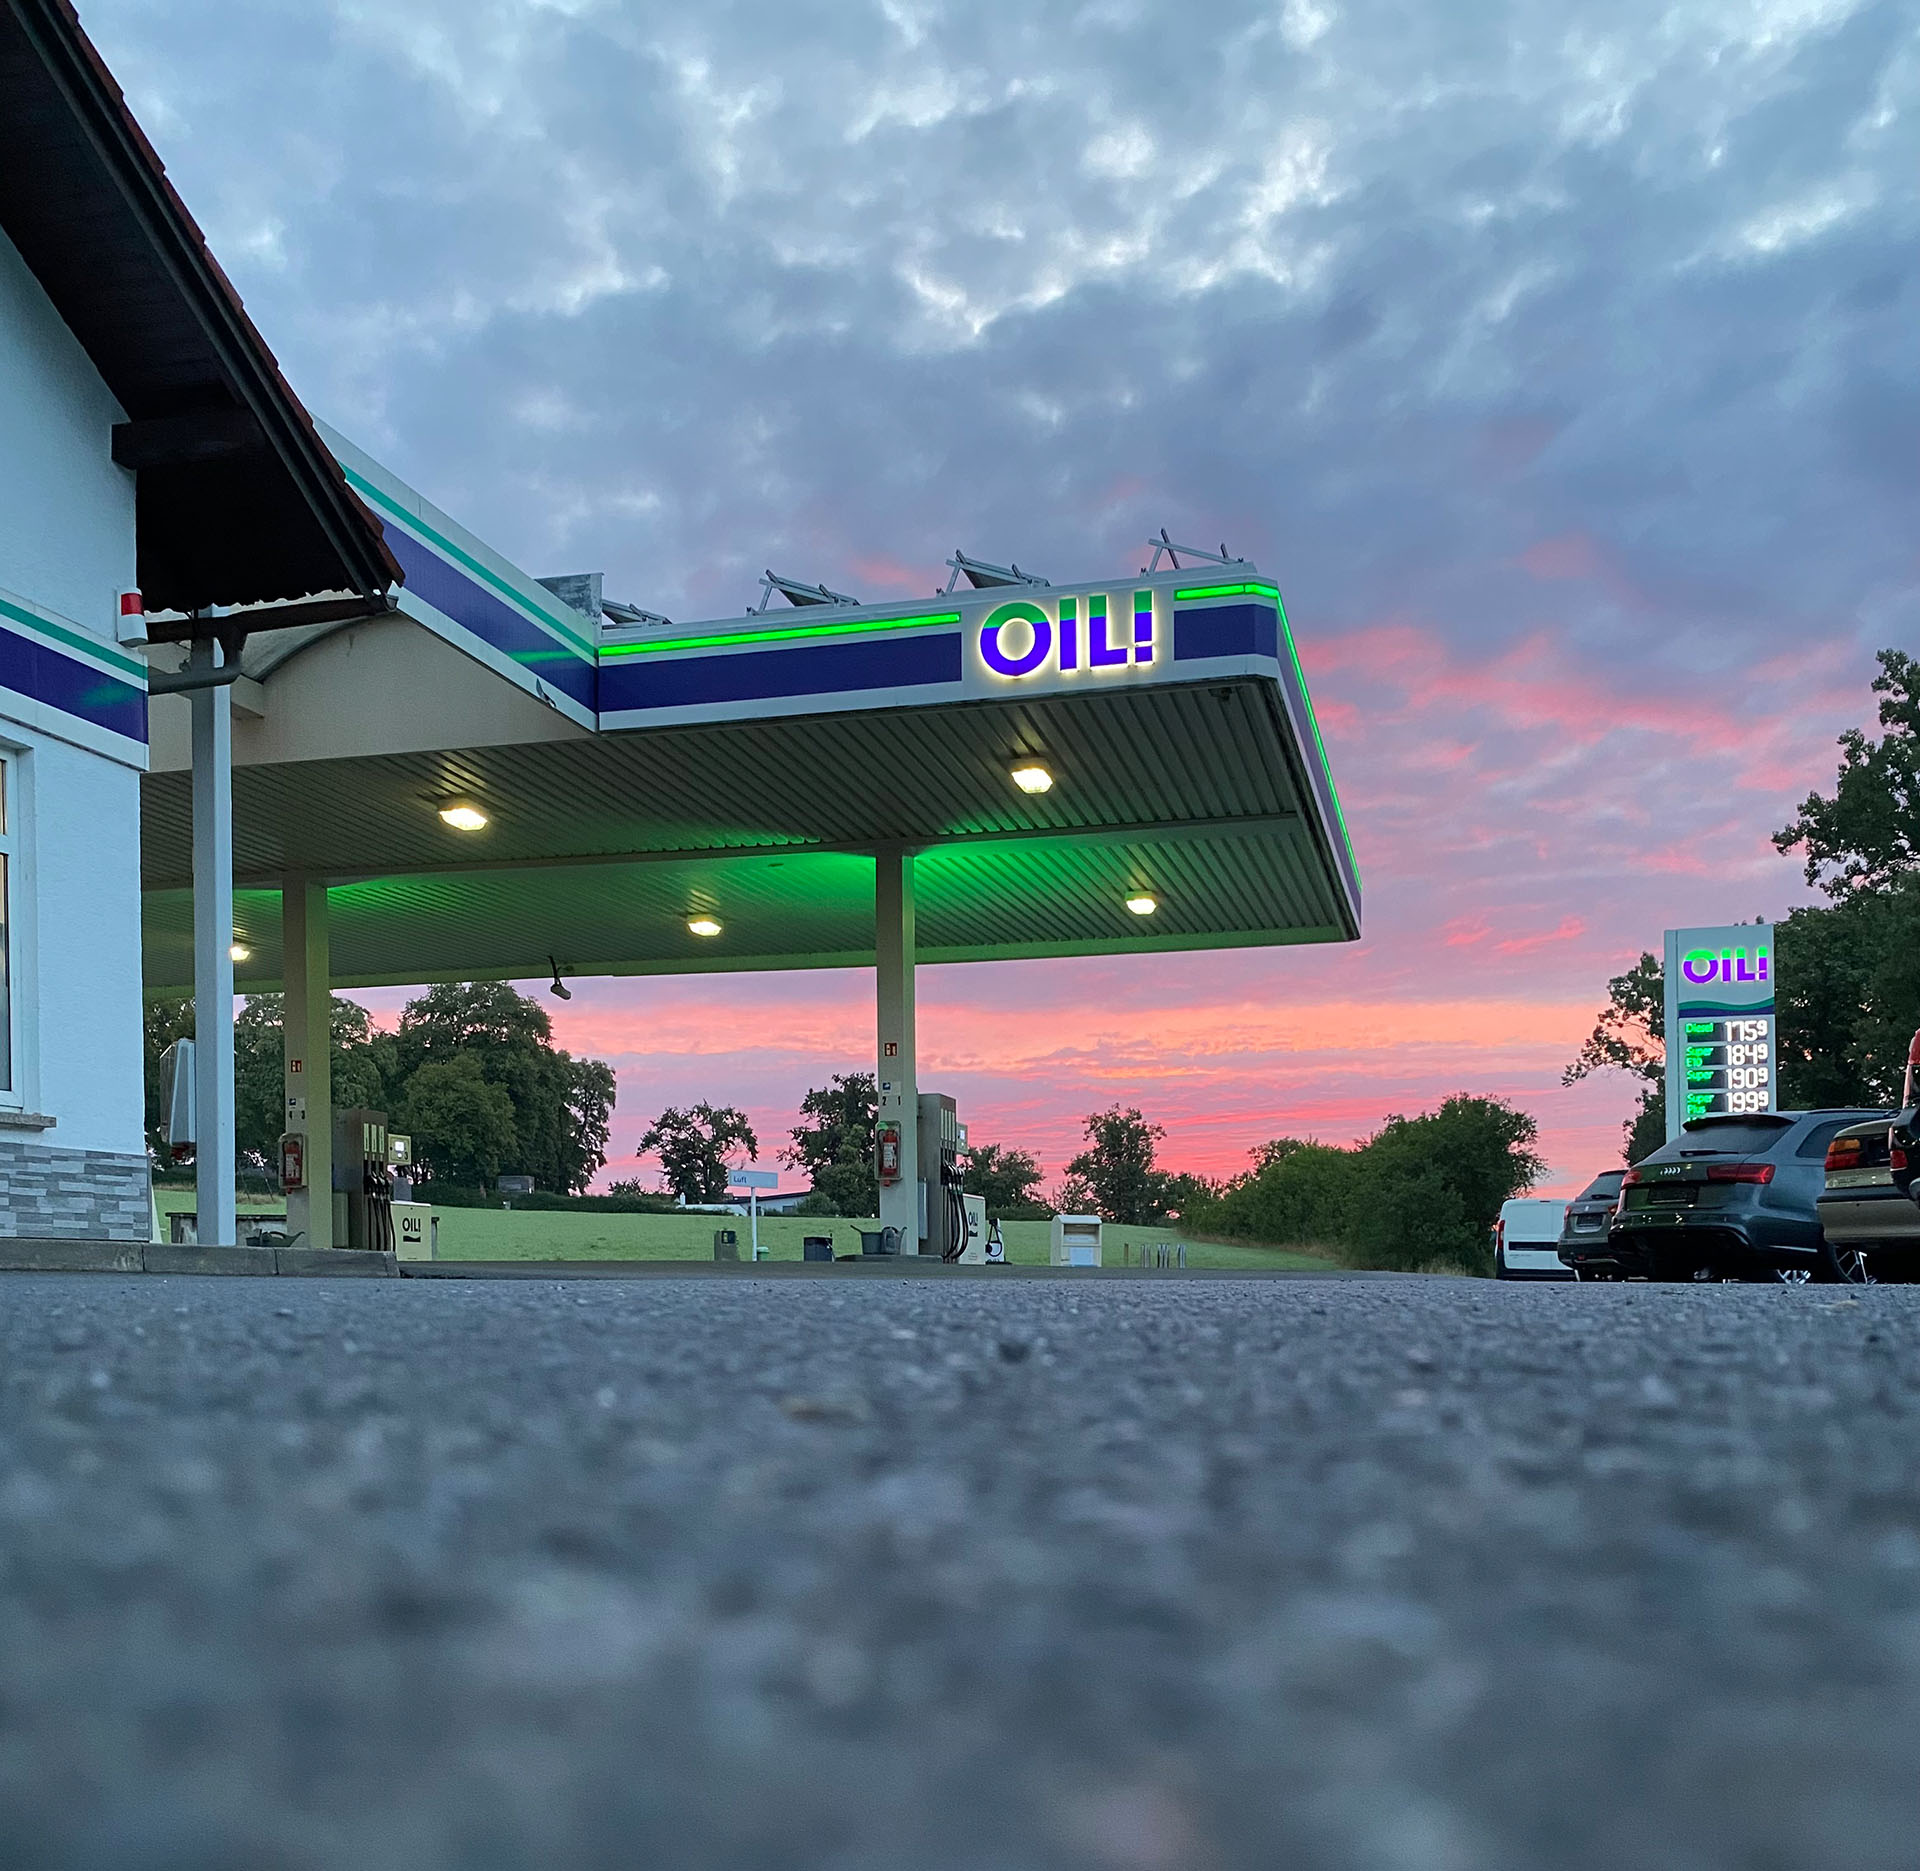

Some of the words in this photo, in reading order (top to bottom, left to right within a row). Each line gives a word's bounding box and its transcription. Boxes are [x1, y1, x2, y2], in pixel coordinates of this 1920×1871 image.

[980, 590, 1153, 677] OIL!
[1683, 946, 1768, 984] OIL!
[1686, 1046, 1714, 1057] Super
[1687, 1070, 1714, 1081] Super
[1687, 1093, 1715, 1104] Super
[402, 1217, 421, 1233] OIL!
